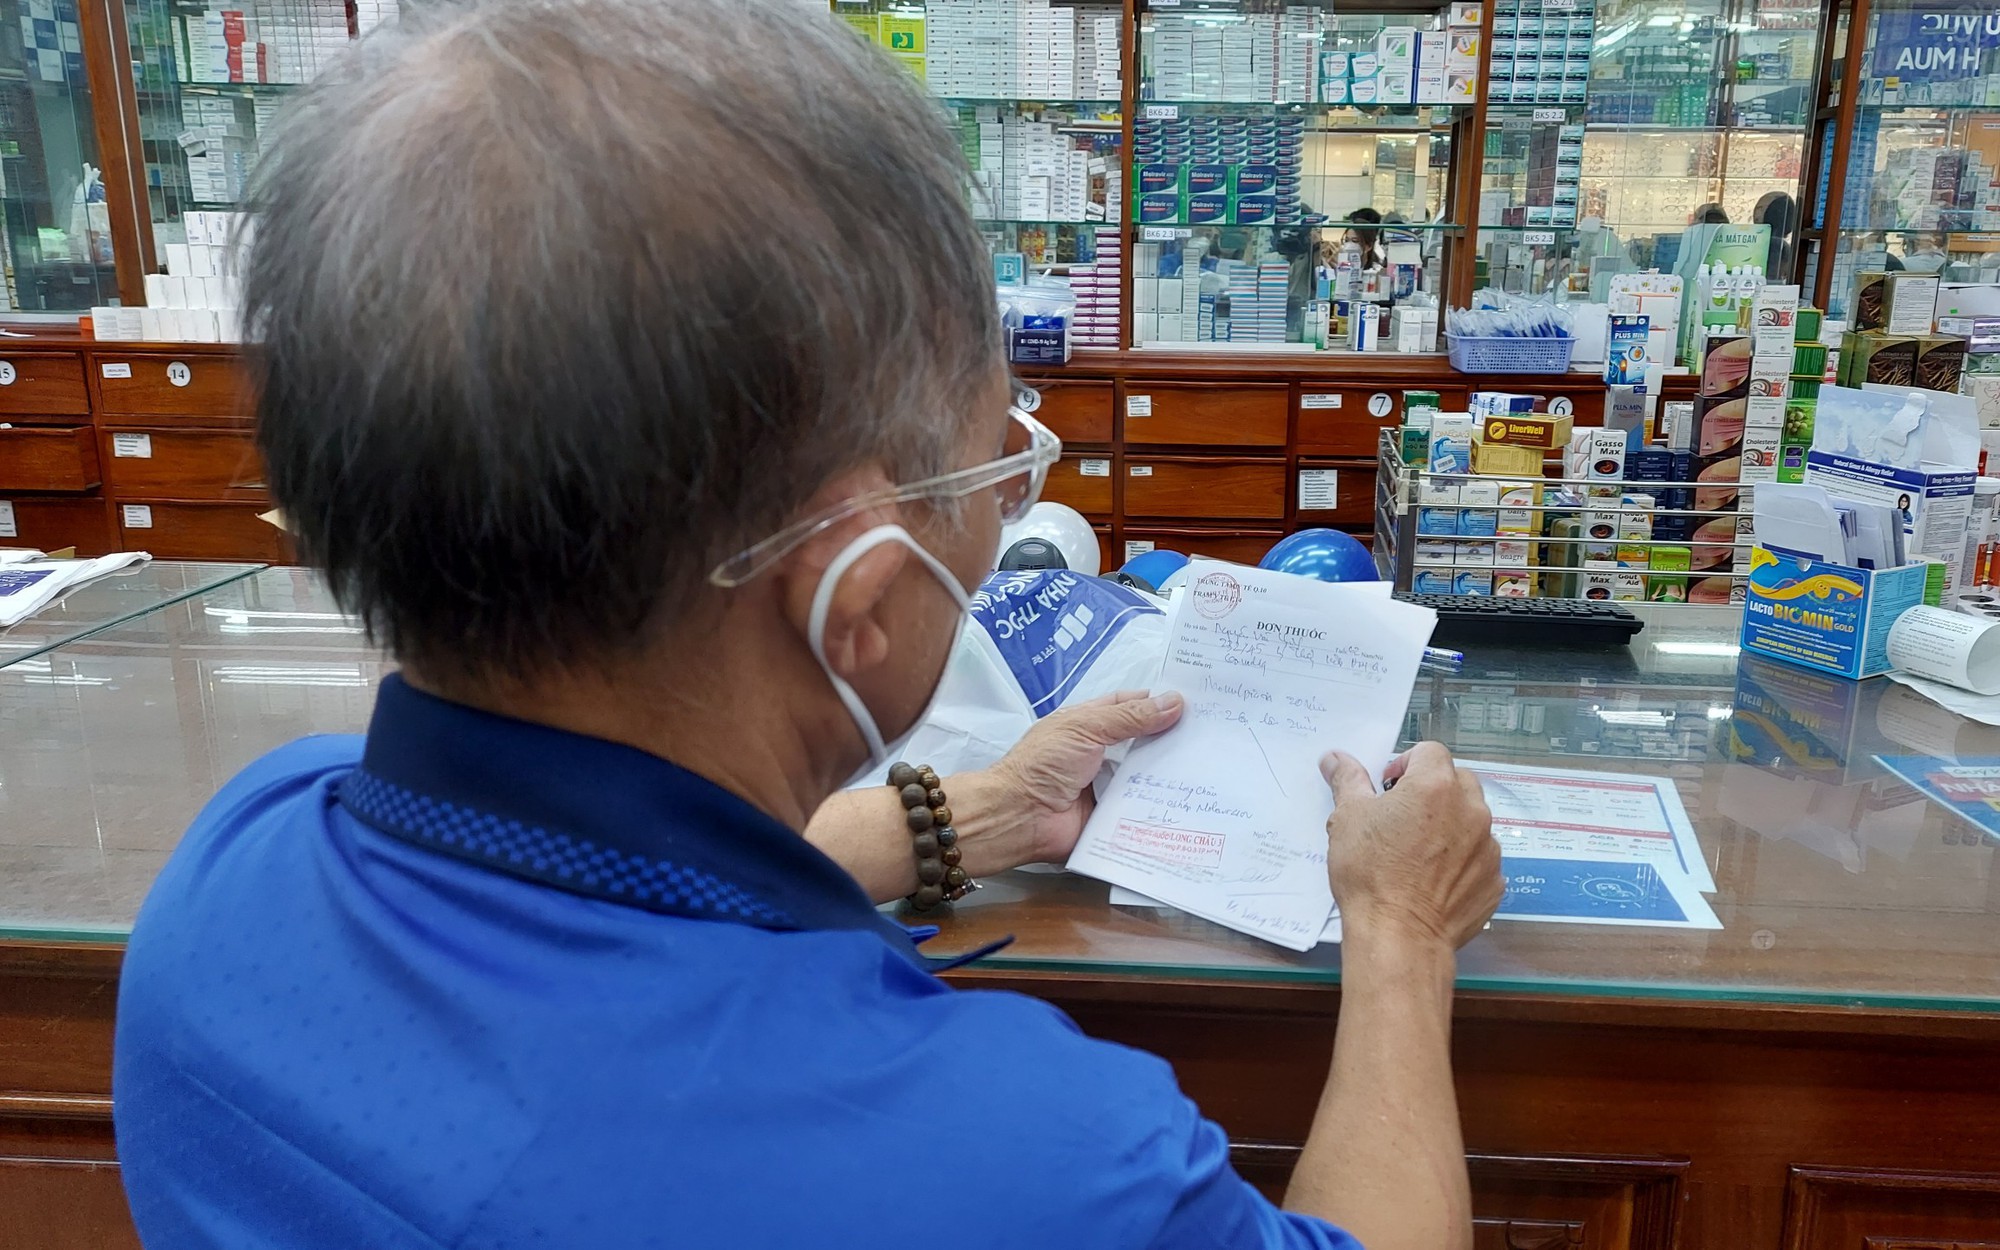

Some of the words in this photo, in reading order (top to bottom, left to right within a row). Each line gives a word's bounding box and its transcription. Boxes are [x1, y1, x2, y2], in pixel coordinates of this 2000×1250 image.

[1742, 235, 1758, 243] GAN
[172, 370, 185, 380] 14
[1024, 392, 1034, 408] 9
[1374, 396, 1386, 414] 7
[1555, 400, 1566, 415] 6
[1509, 424, 1544, 435] LiverWell
[1595, 440, 1624, 448] Gasso
[1198, 578, 1218, 586] TRUNG
[1750, 600, 1774, 616] LACTO
[1774, 603, 1834, 632] BIOMIN
[1834, 624, 1855, 632] GOLD
[1257, 621, 1280, 633] ĐƠN
[1285, 626, 1327, 640] THUỐC
